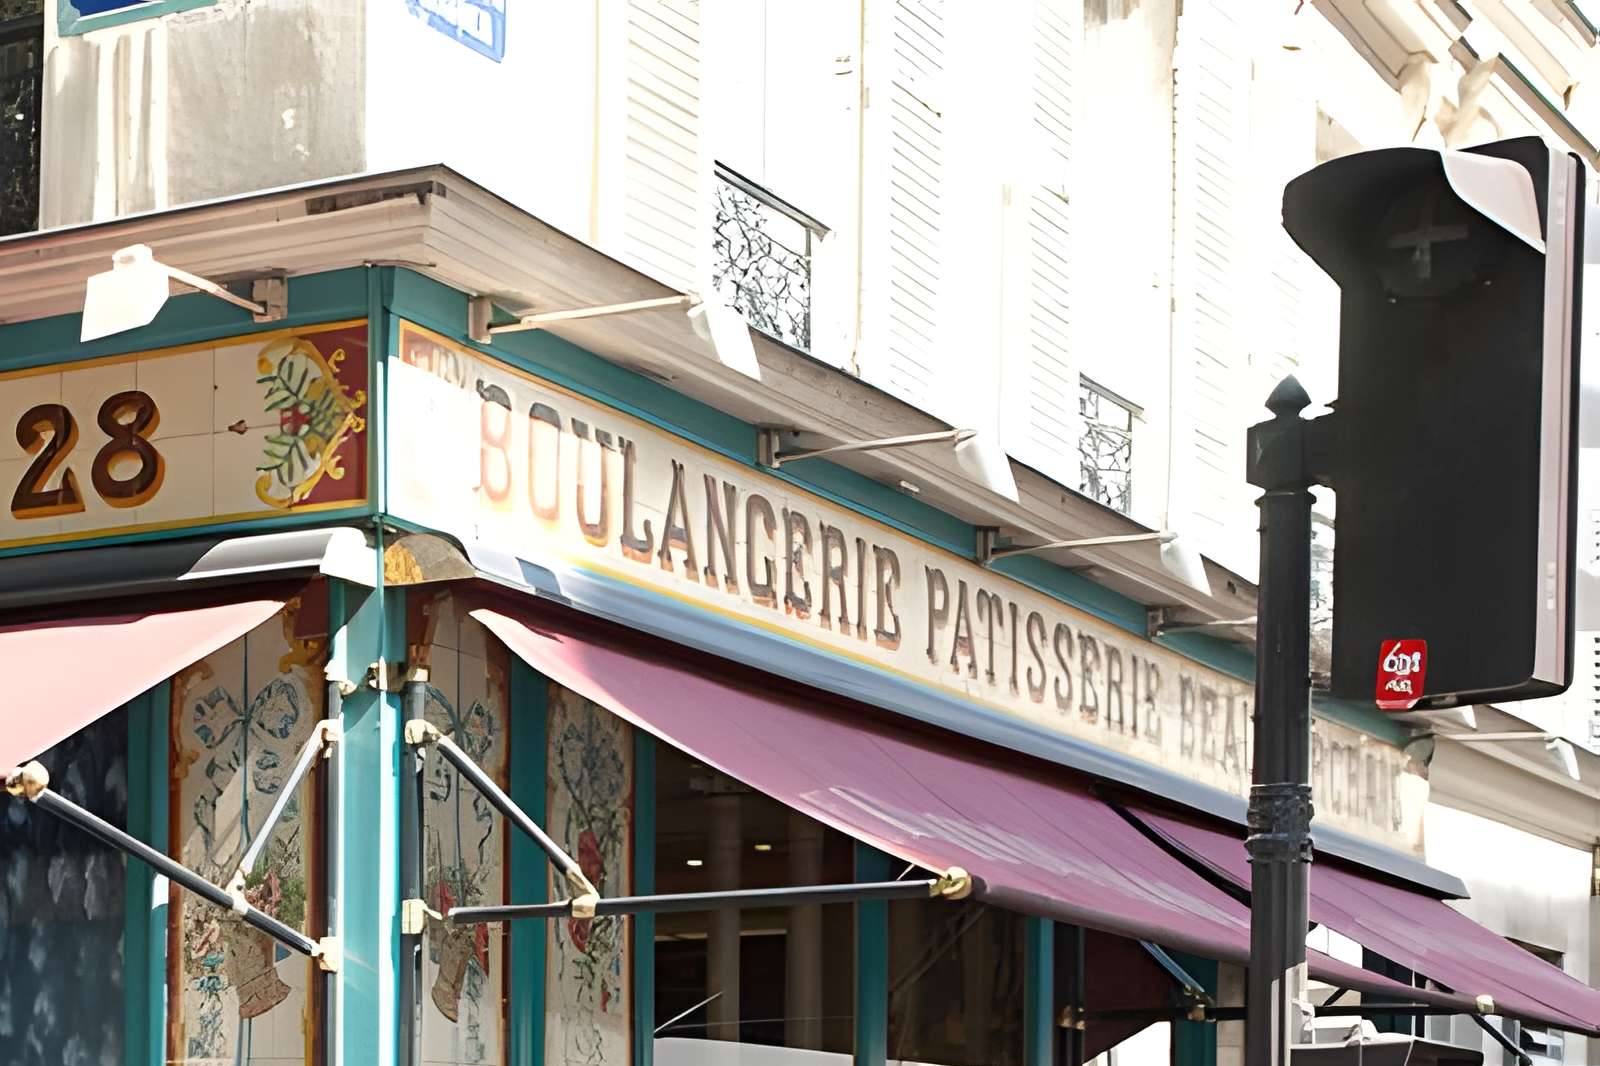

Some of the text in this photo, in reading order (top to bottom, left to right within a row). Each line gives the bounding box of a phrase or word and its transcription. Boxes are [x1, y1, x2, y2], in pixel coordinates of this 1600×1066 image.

[10, 390, 166, 520] 28
[474, 377, 902, 651] BOULANGERIE
[924, 563, 1163, 746] PATISSERIE
